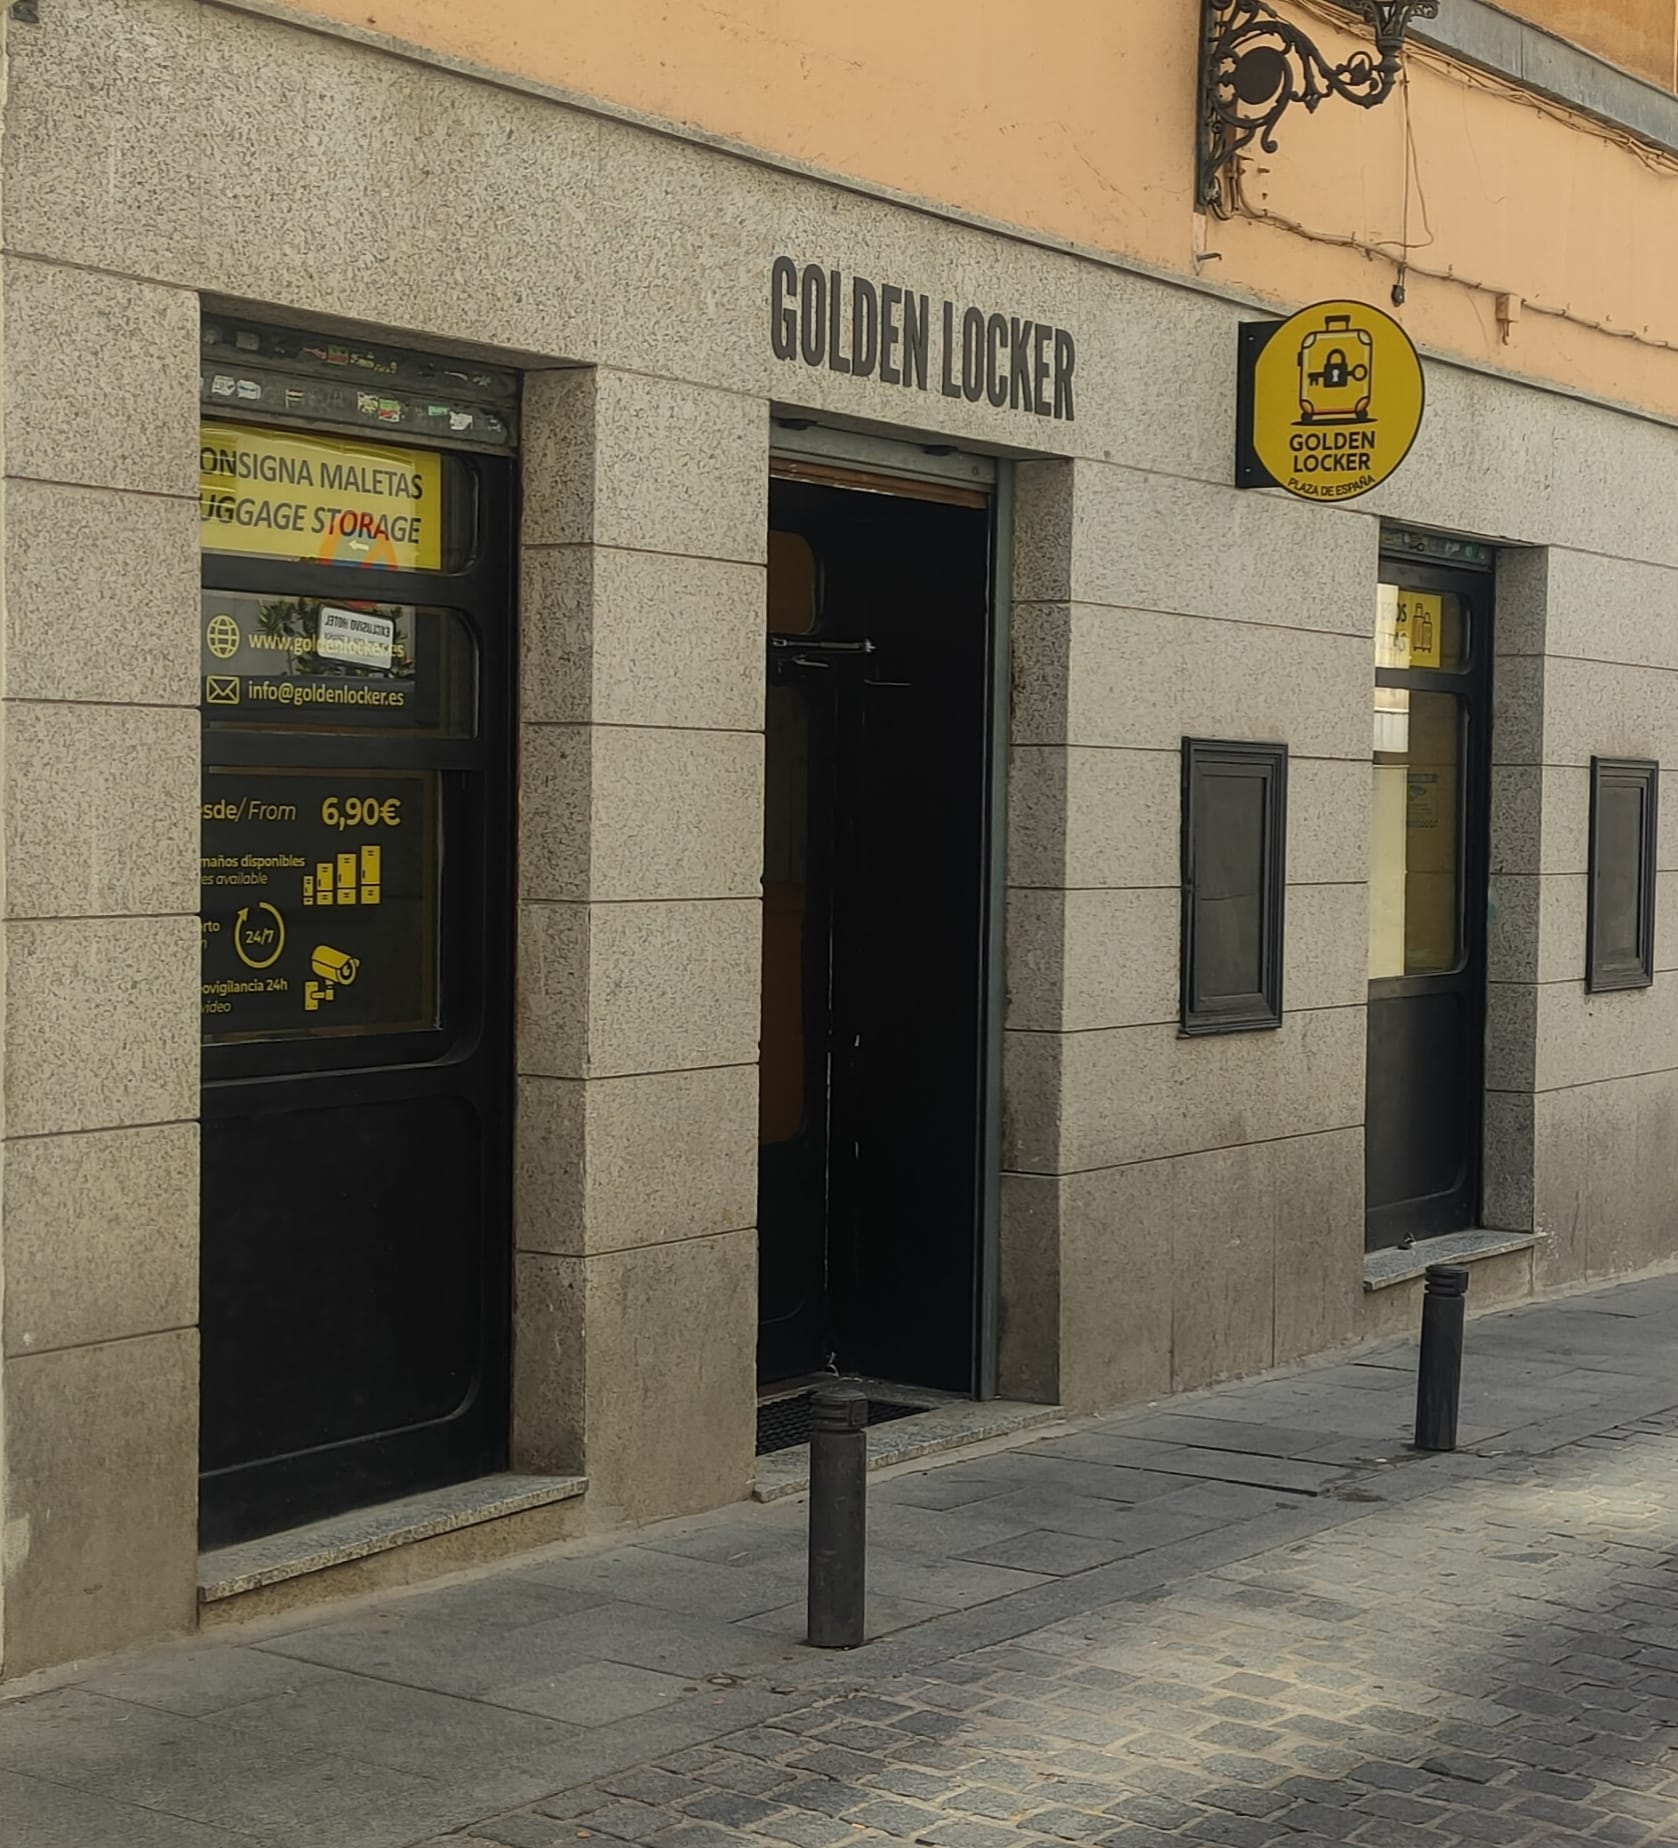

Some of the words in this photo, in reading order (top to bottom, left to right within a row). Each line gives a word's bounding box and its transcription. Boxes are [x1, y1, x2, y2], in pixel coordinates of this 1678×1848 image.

[771, 255, 930, 391] GOLDEN
[941, 300, 1075, 421] LOCKER
[1289, 430, 1376, 452] GOLDEN
[1293, 452, 1371, 473] LOCKER
[320, 461, 423, 500] MALETAS
[1287, 478, 1319, 496] PLAZA
[1321, 485, 1334, 496] DE
[1335, 474, 1376, 495] ESPAÑA
[311, 505, 422, 544] STORAGE
[248, 632, 405, 658] www.goldenlocker.es
[248, 680, 405, 706] info@goldenlocker.es
[321, 797, 401, 831] 6,90€
[240, 854, 306, 870] disponibles
[215, 872, 268, 885] available
[245, 928, 274, 945] 24/7
[265, 978, 288, 991] 24h
